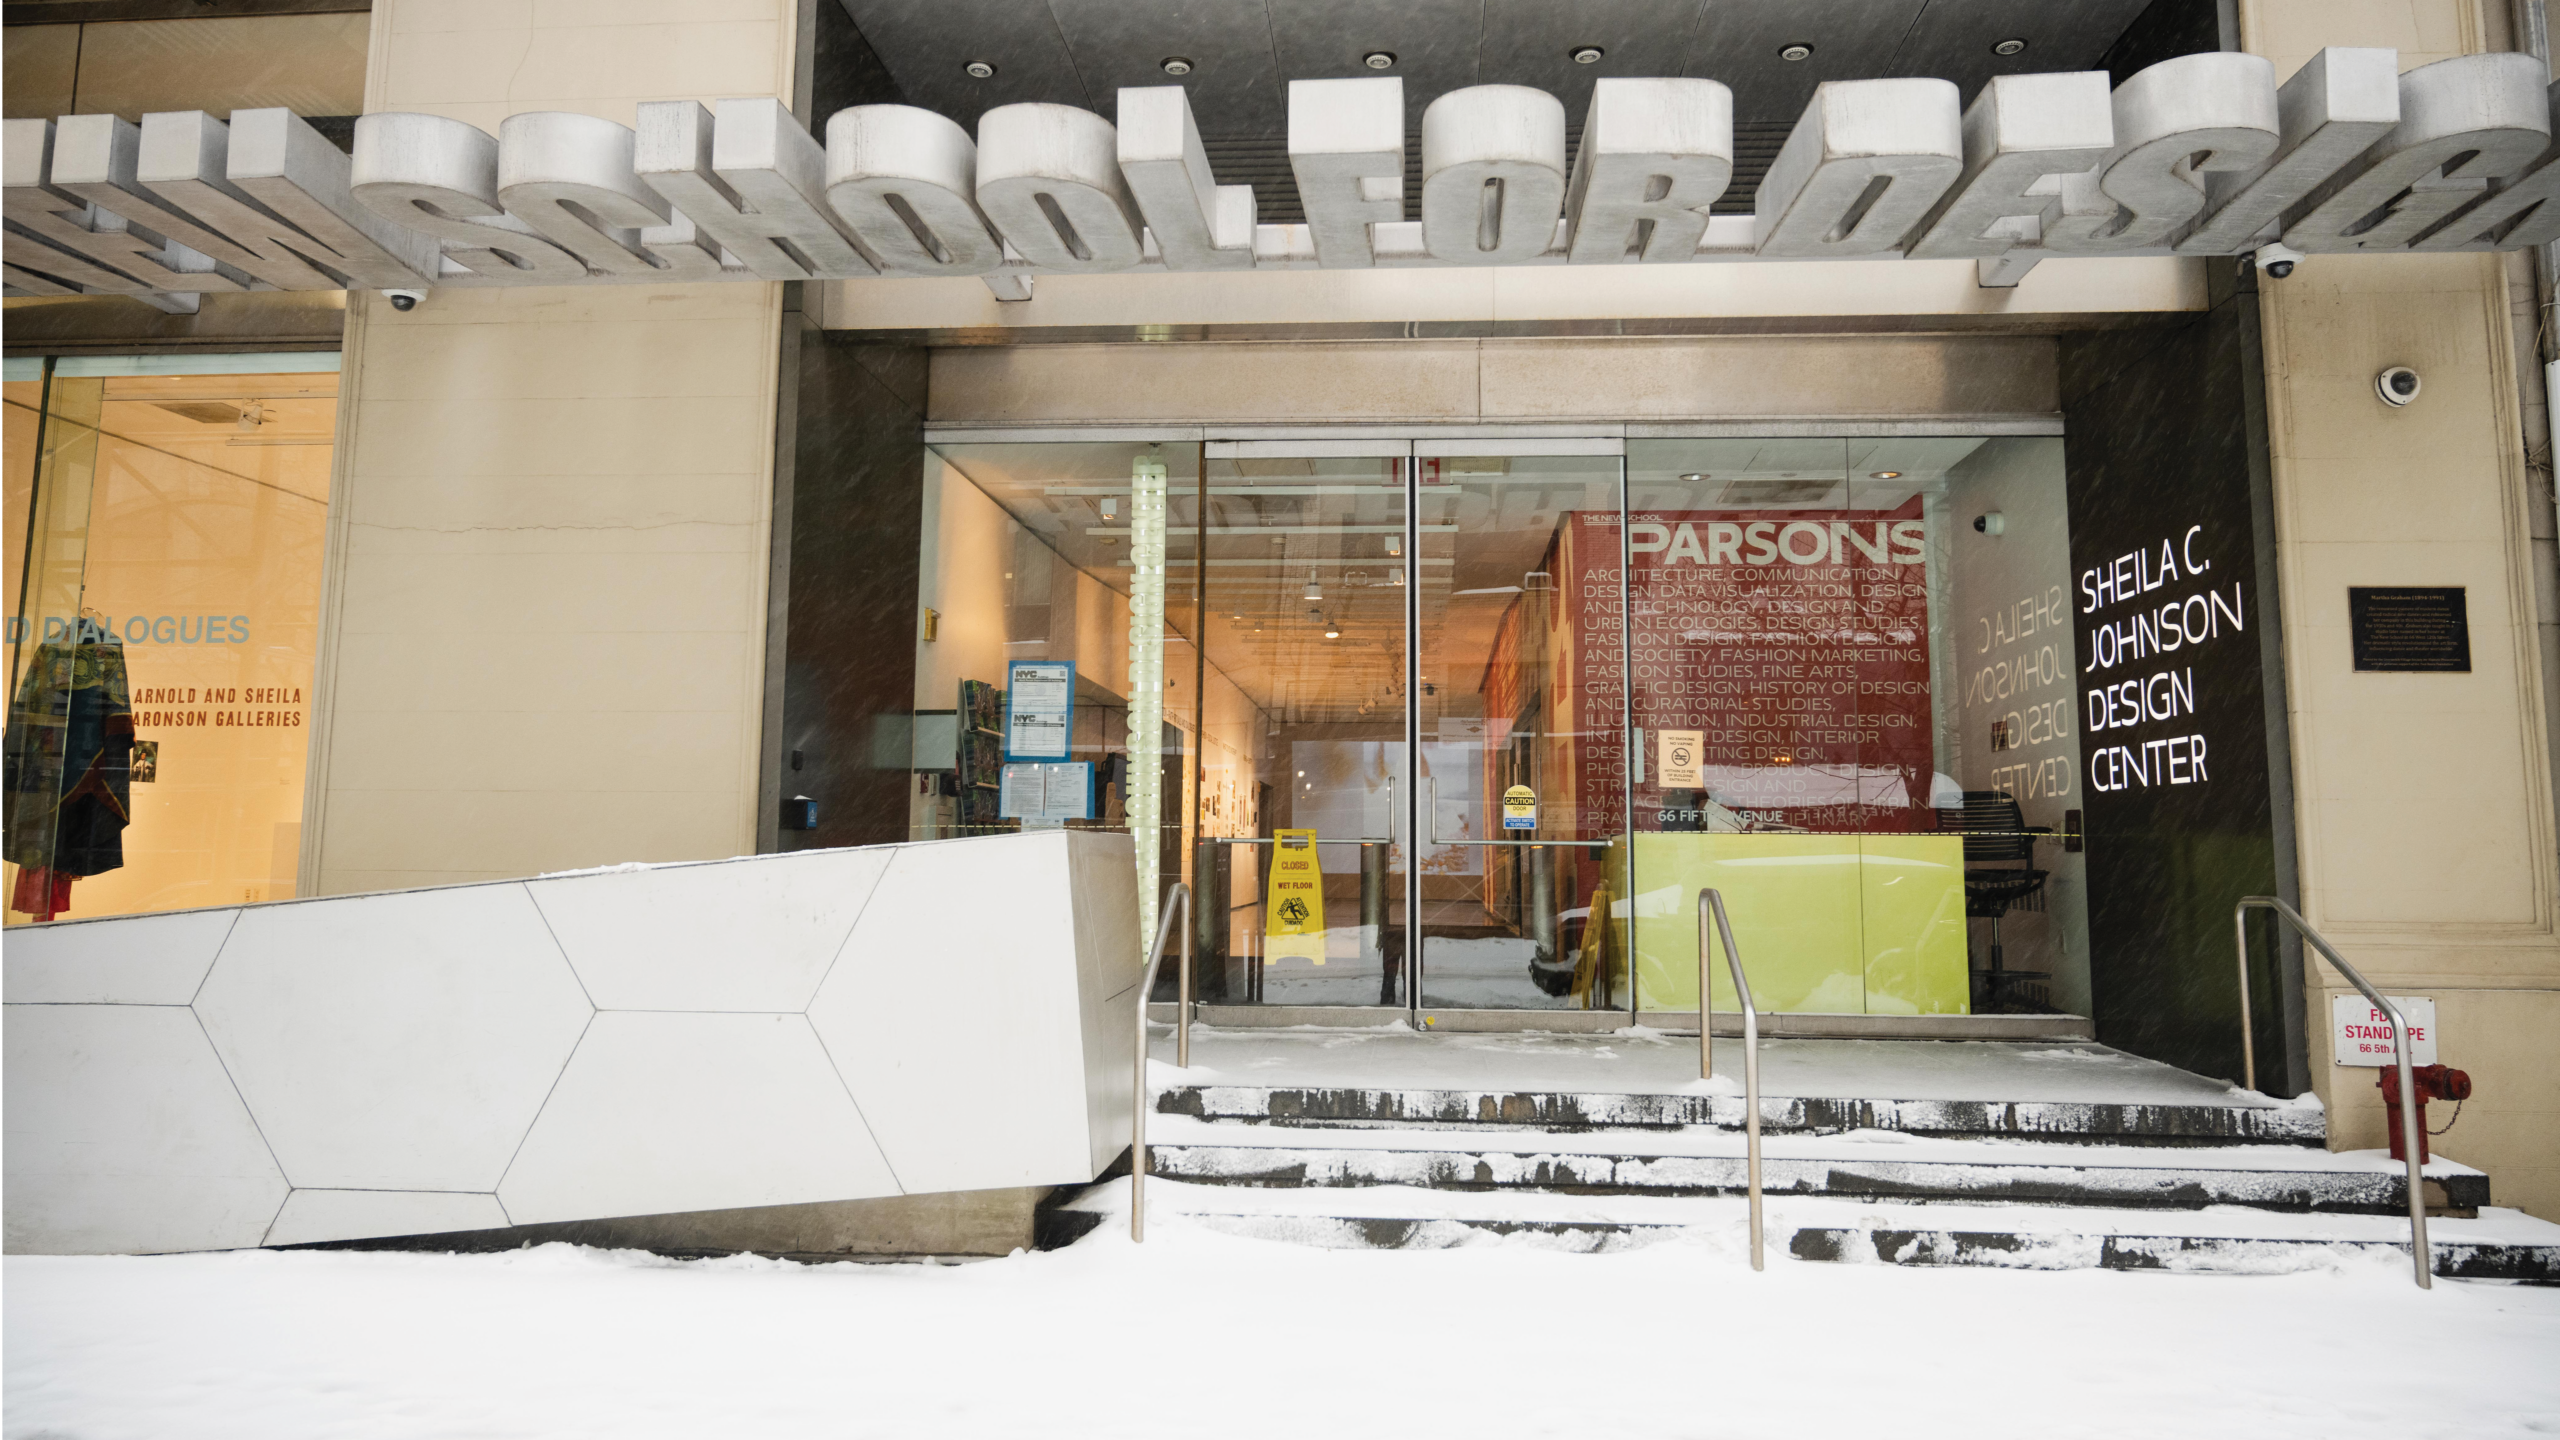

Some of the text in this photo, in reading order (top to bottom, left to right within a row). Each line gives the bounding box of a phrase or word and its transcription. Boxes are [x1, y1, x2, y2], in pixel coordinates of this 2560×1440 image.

[350, 86, 1257, 276] SCHOOL
[1288, 77, 1734, 266] FOR
[1582, 514, 1599, 522] THE
[1628, 521, 1926, 565] PARSONS
[1583, 569, 1898, 583] ARCHITECTURE, COMMUNICATION
[2081, 525, 2210, 614] SHEILA C.
[1661, 585, 1705, 597] DATA
[1711, 585, 1856, 599] VISUALIZATION,
[1583, 601, 1884, 614] AND TECHNOLOGY, DESIGN AND
[42, 616, 250, 644] DIALOGUES
[1656, 617, 1761, 631] ECOLOGIES,
[1766, 617, 1834, 629] DESIGN
[1840, 617, 1923, 631] STUDIES,
[2085, 582, 2243, 673] JOHNSON
[1674, 633, 1747, 647] DESIGN,
[1752, 633, 1837, 646] FASHION
[1843, 633, 1911, 646] DESIGN
[1584, 649, 1924, 664] AND SOCIETY, FASHION MARKETING,
[1016, 670, 1037, 678] NYC
[1674, 665, 1757, 679] STUDIES,
[1762, 665, 1804, 677] FINE
[1808, 665, 1859, 679] ARTS,
[1585, 681, 1930, 696] GRAHIC DESIGN, HISTORY OF DESIGN
[134, 688, 301, 704] ARNOLD AND SHEILA
[2088, 667, 2194, 732] DESIGN
[1585, 698, 1836, 712] AND CURATORIAL STUDIES,
[132, 711, 300, 727] ARONSON GALLERIES
[1726, 714, 1839, 727] INDUSTRIAL
[1844, 714, 1918, 729] DESIGN,
[1712, 730, 1785, 744] DESIGN,
[1790, 730, 1880, 743] INTERIOR
[1586, 746, 1659, 760] DESIN,
[1755, 747, 1828, 761] DESIGN,
[1741, 763, 1830, 776] PRODUCT
[2091, 734, 2208, 792] CENTER
[1764, 780, 1806, 792] AND
[1505, 797, 1534, 805] CAUTION
[1658, 810, 1783, 822] 66 FIFT VENUE
[2345, 1025, 2425, 1041] STANDPE
[2359, 1043, 2372, 1053] 66
[2374, 1044, 2390, 1054] 5th
